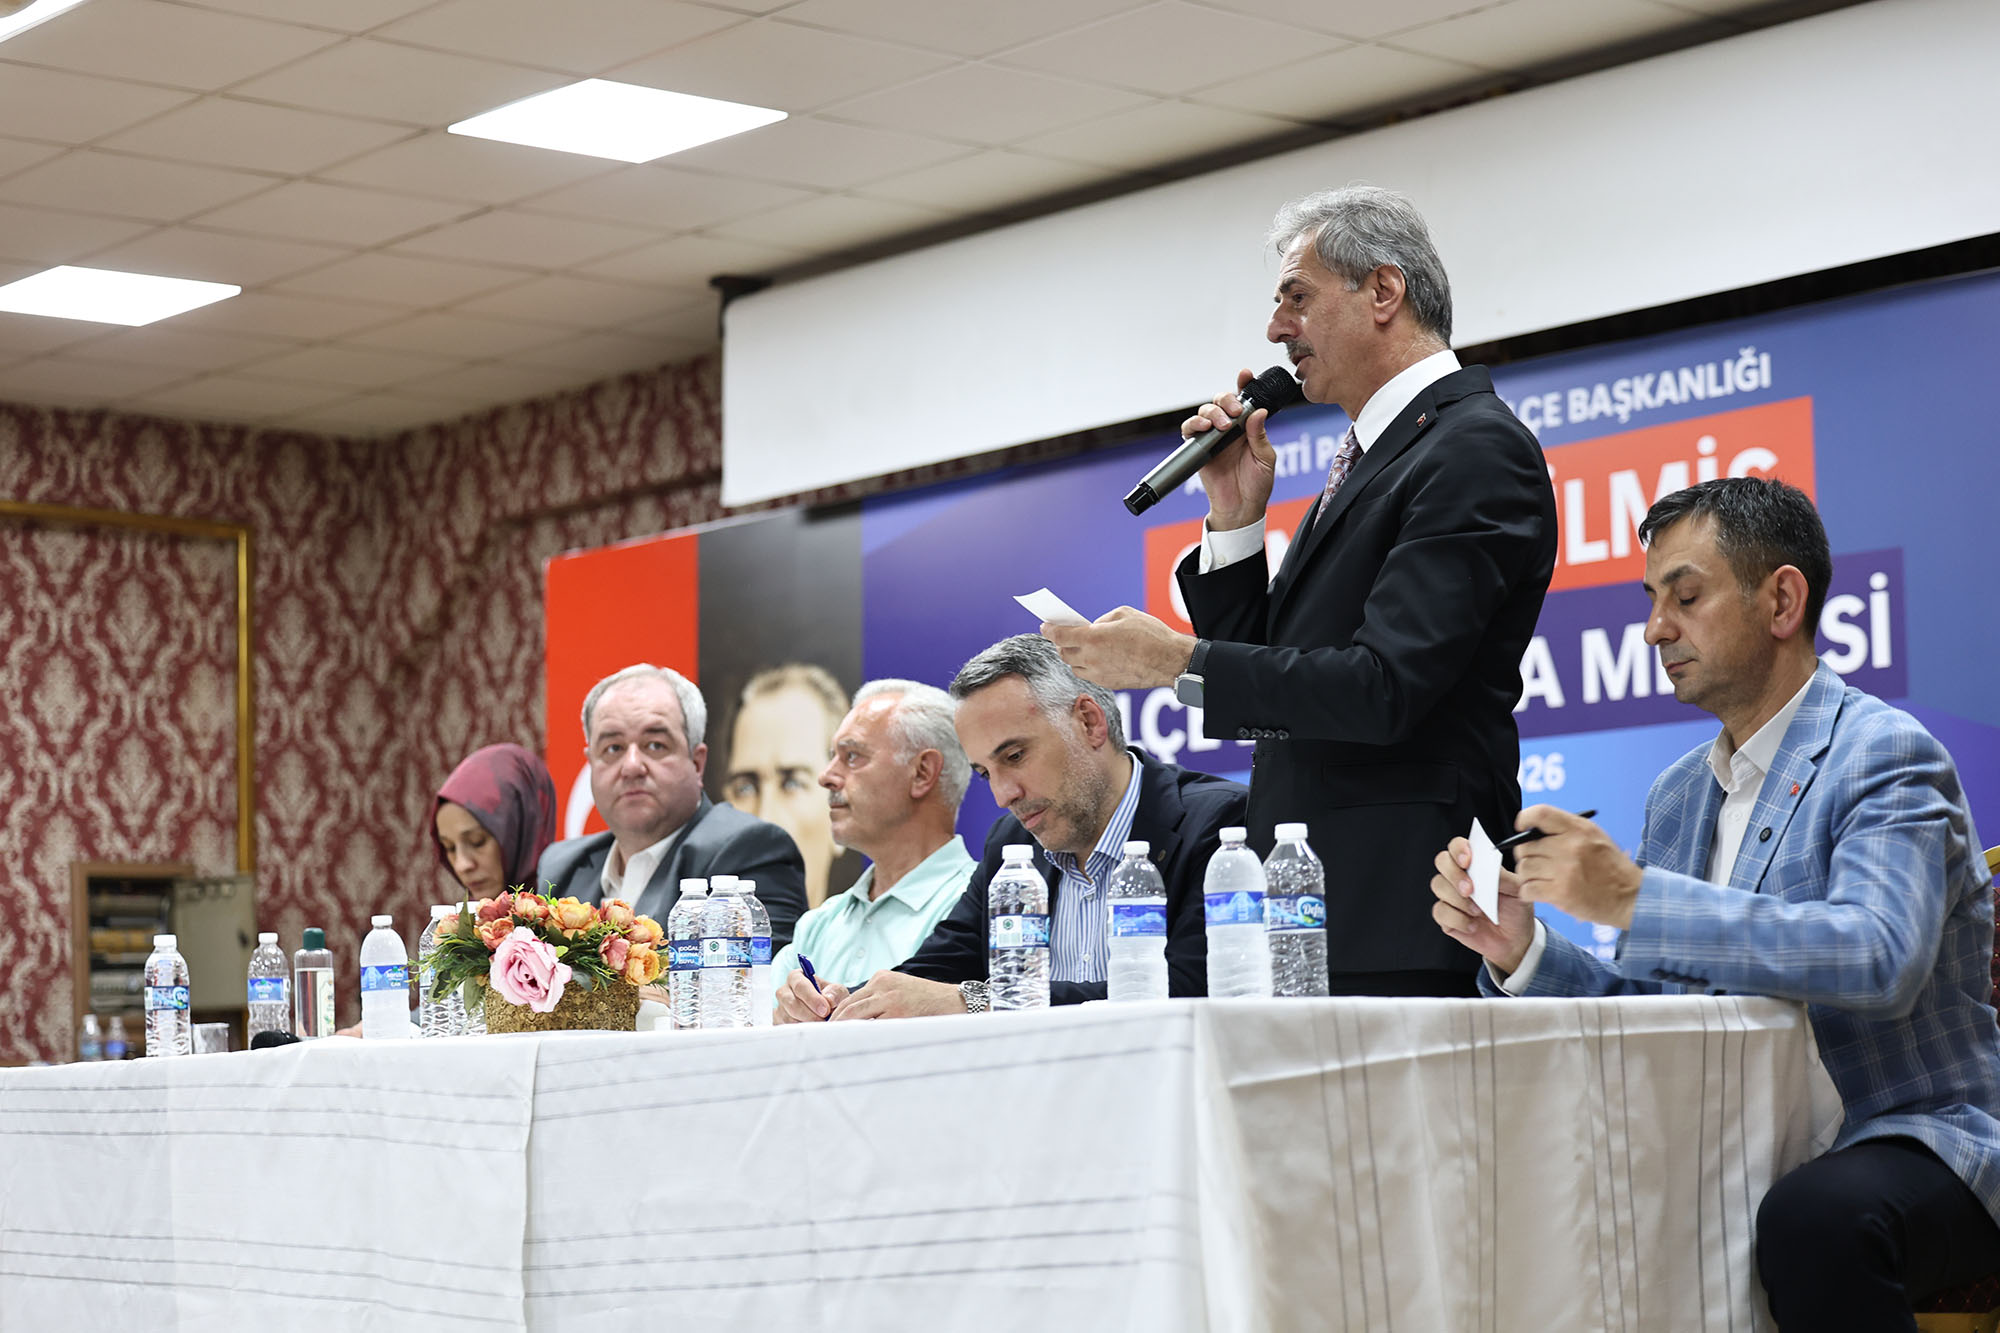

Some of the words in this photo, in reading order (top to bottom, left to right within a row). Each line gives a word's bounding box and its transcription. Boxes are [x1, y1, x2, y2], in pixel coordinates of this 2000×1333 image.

[1503, 392, 1563, 438] ÇE
[1567, 346, 1772, 424] BAŞKANLIĞI
[1519, 752, 1566, 793] 26
